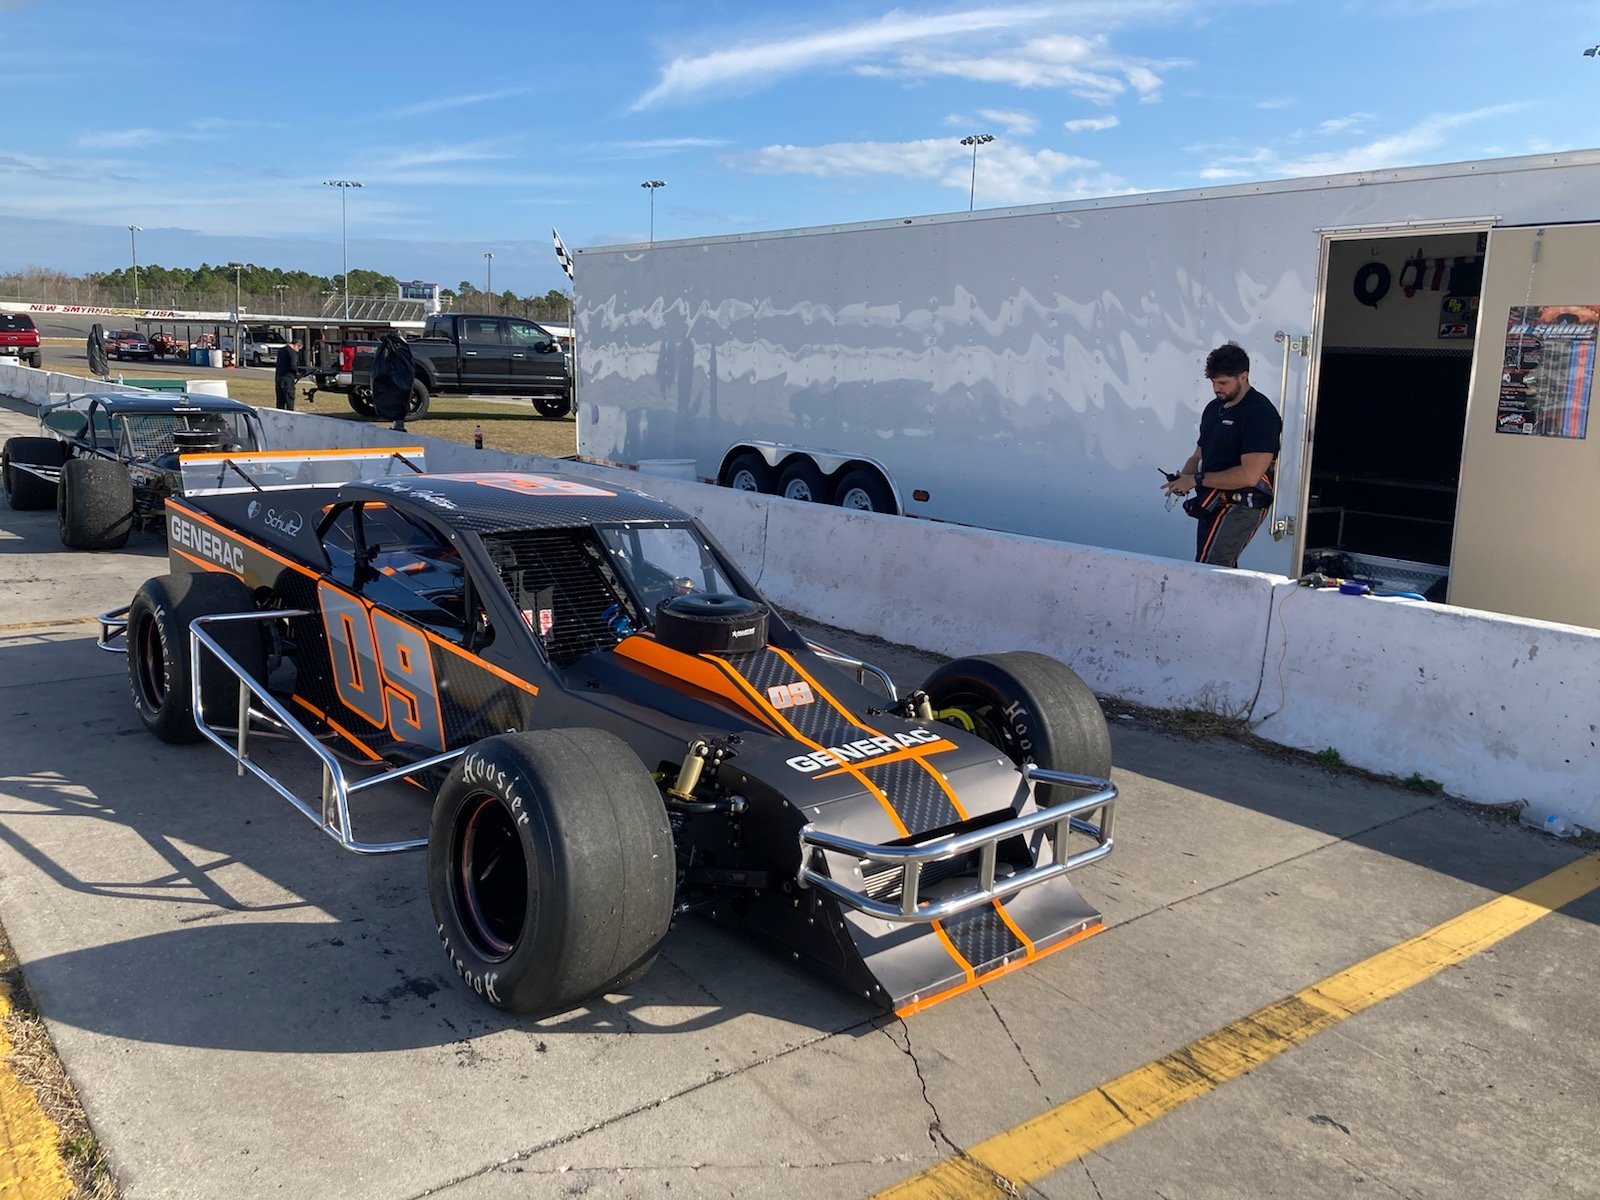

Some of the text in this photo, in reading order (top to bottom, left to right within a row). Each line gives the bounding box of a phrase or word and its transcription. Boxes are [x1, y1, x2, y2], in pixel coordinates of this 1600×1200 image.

[30, 304, 57, 312] NEW
[63, 305, 110, 315] SMYRNA
[171, 514, 244, 574] GENERAC
[264, 508, 301, 537] Schultz
[317, 577, 447, 753] 09
[767, 681, 815, 710] 09
[785, 728, 942, 773] GENERAC
[462, 752, 530, 826] Hoosier
